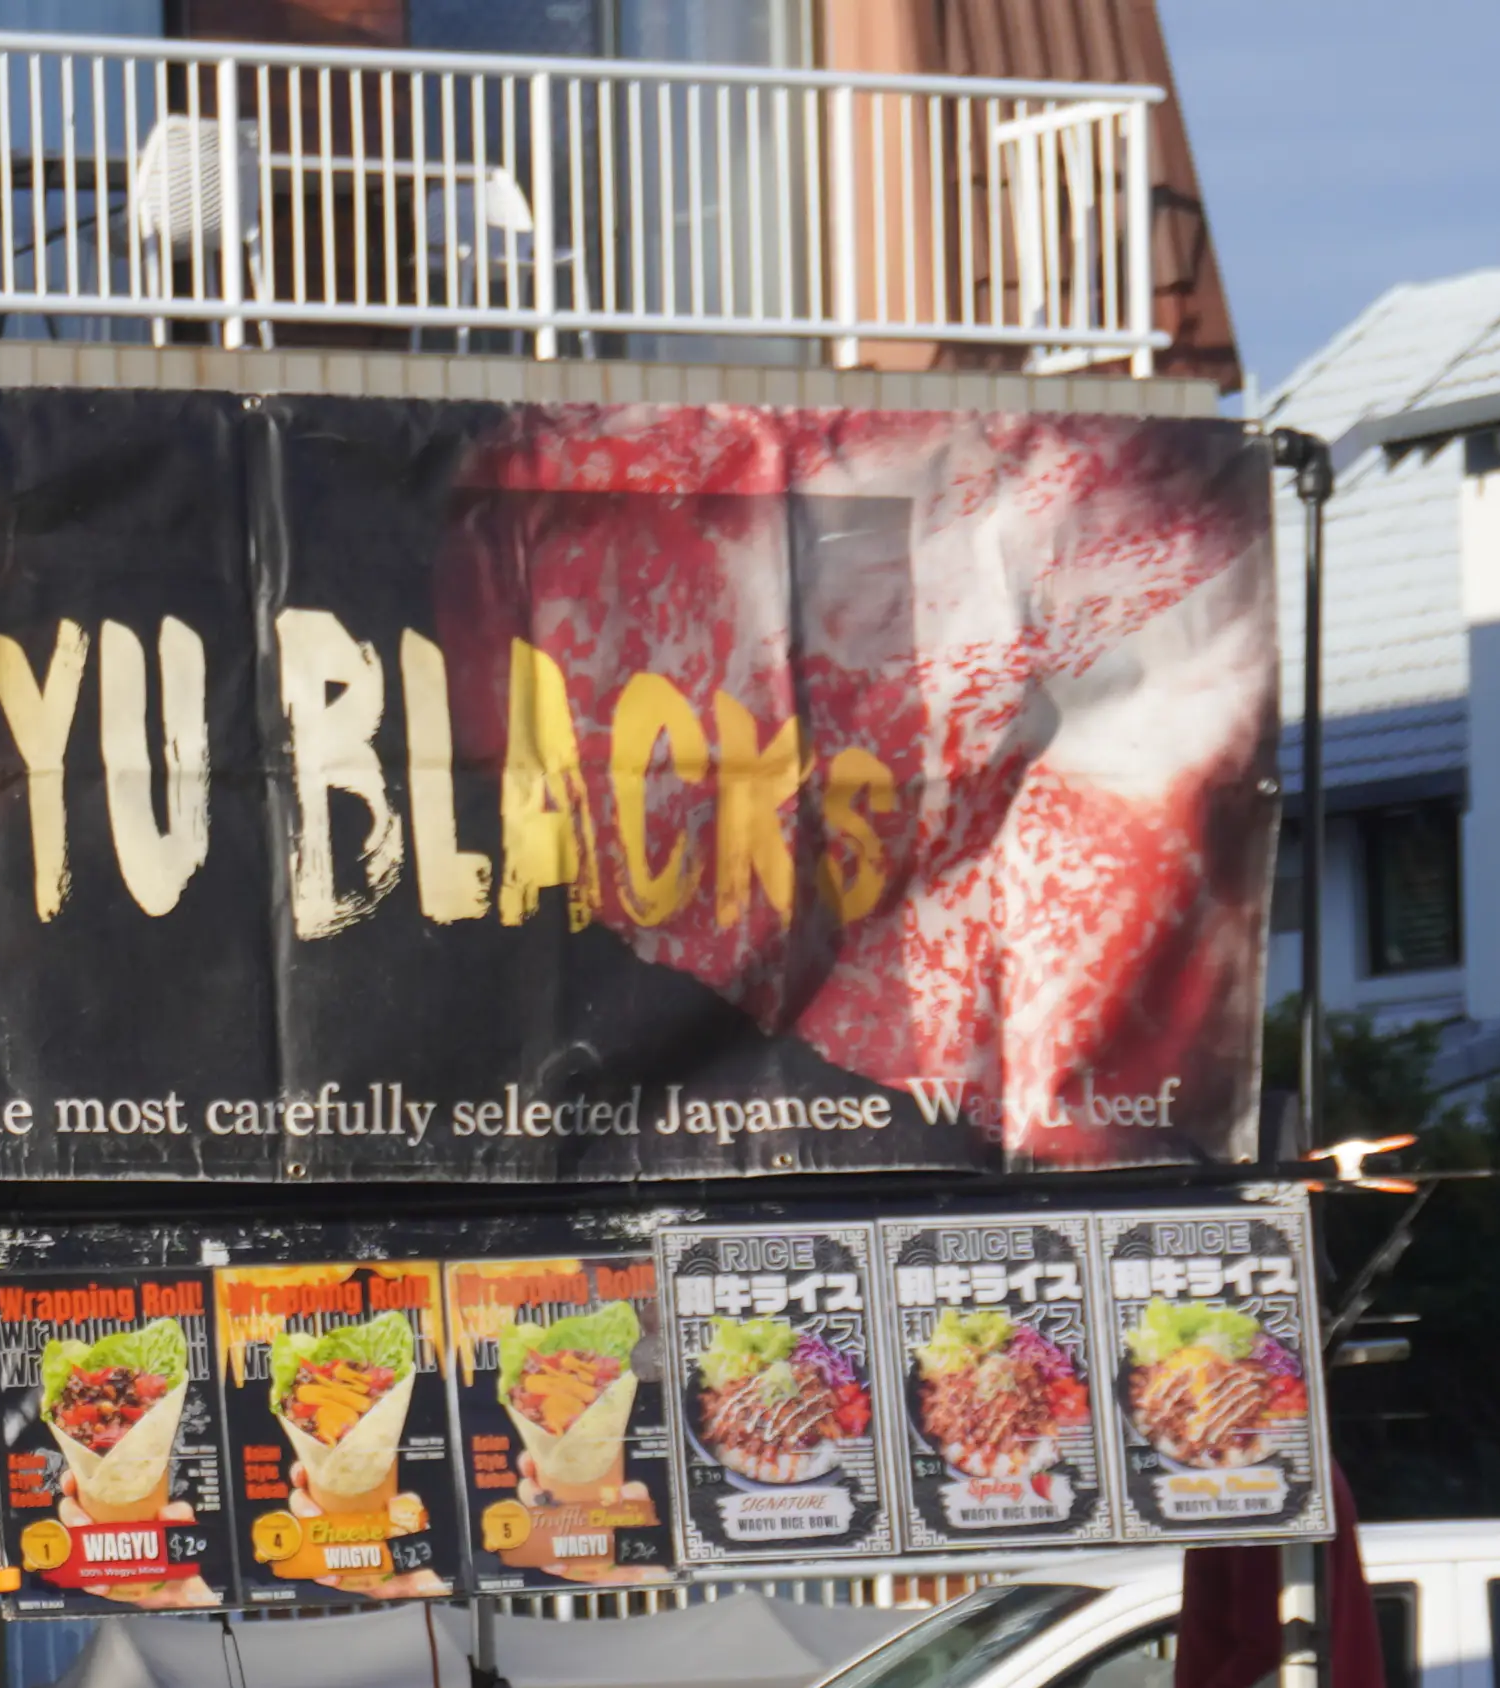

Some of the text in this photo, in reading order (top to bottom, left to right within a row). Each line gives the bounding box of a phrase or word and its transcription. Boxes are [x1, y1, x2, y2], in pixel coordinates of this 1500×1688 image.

[276, 607, 896, 941] BLACKS
[55, 1089, 187, 1135] most
[205, 1083, 434, 1145] carefully
[452, 1087, 640, 1136] selected
[654, 1083, 891, 1145] Japanese
[1083, 1076, 1180, 1129] beef
[939, 1227, 1034, 1262] RICE
[1155, 1221, 1250, 1256] RICE
[719, 1237, 815, 1271] RICE
[142, 1280, 205, 1317] Roll!
[740, 1493, 828, 1513] SIGNATURE
[967, 1479, 1023, 1504] Spicy
[307, 1520, 386, 1545] Cheese
[503, 1523, 512, 1539] 5
[532, 1508, 586, 1535] Truffle
[738, 1517, 776, 1533] WAGYU
[83, 1531, 158, 1562] WAGYU
[273, 1534, 282, 1549] 4
[552, 1534, 608, 1558] WAGYU
[324, 1547, 381, 1570] WAGYU
